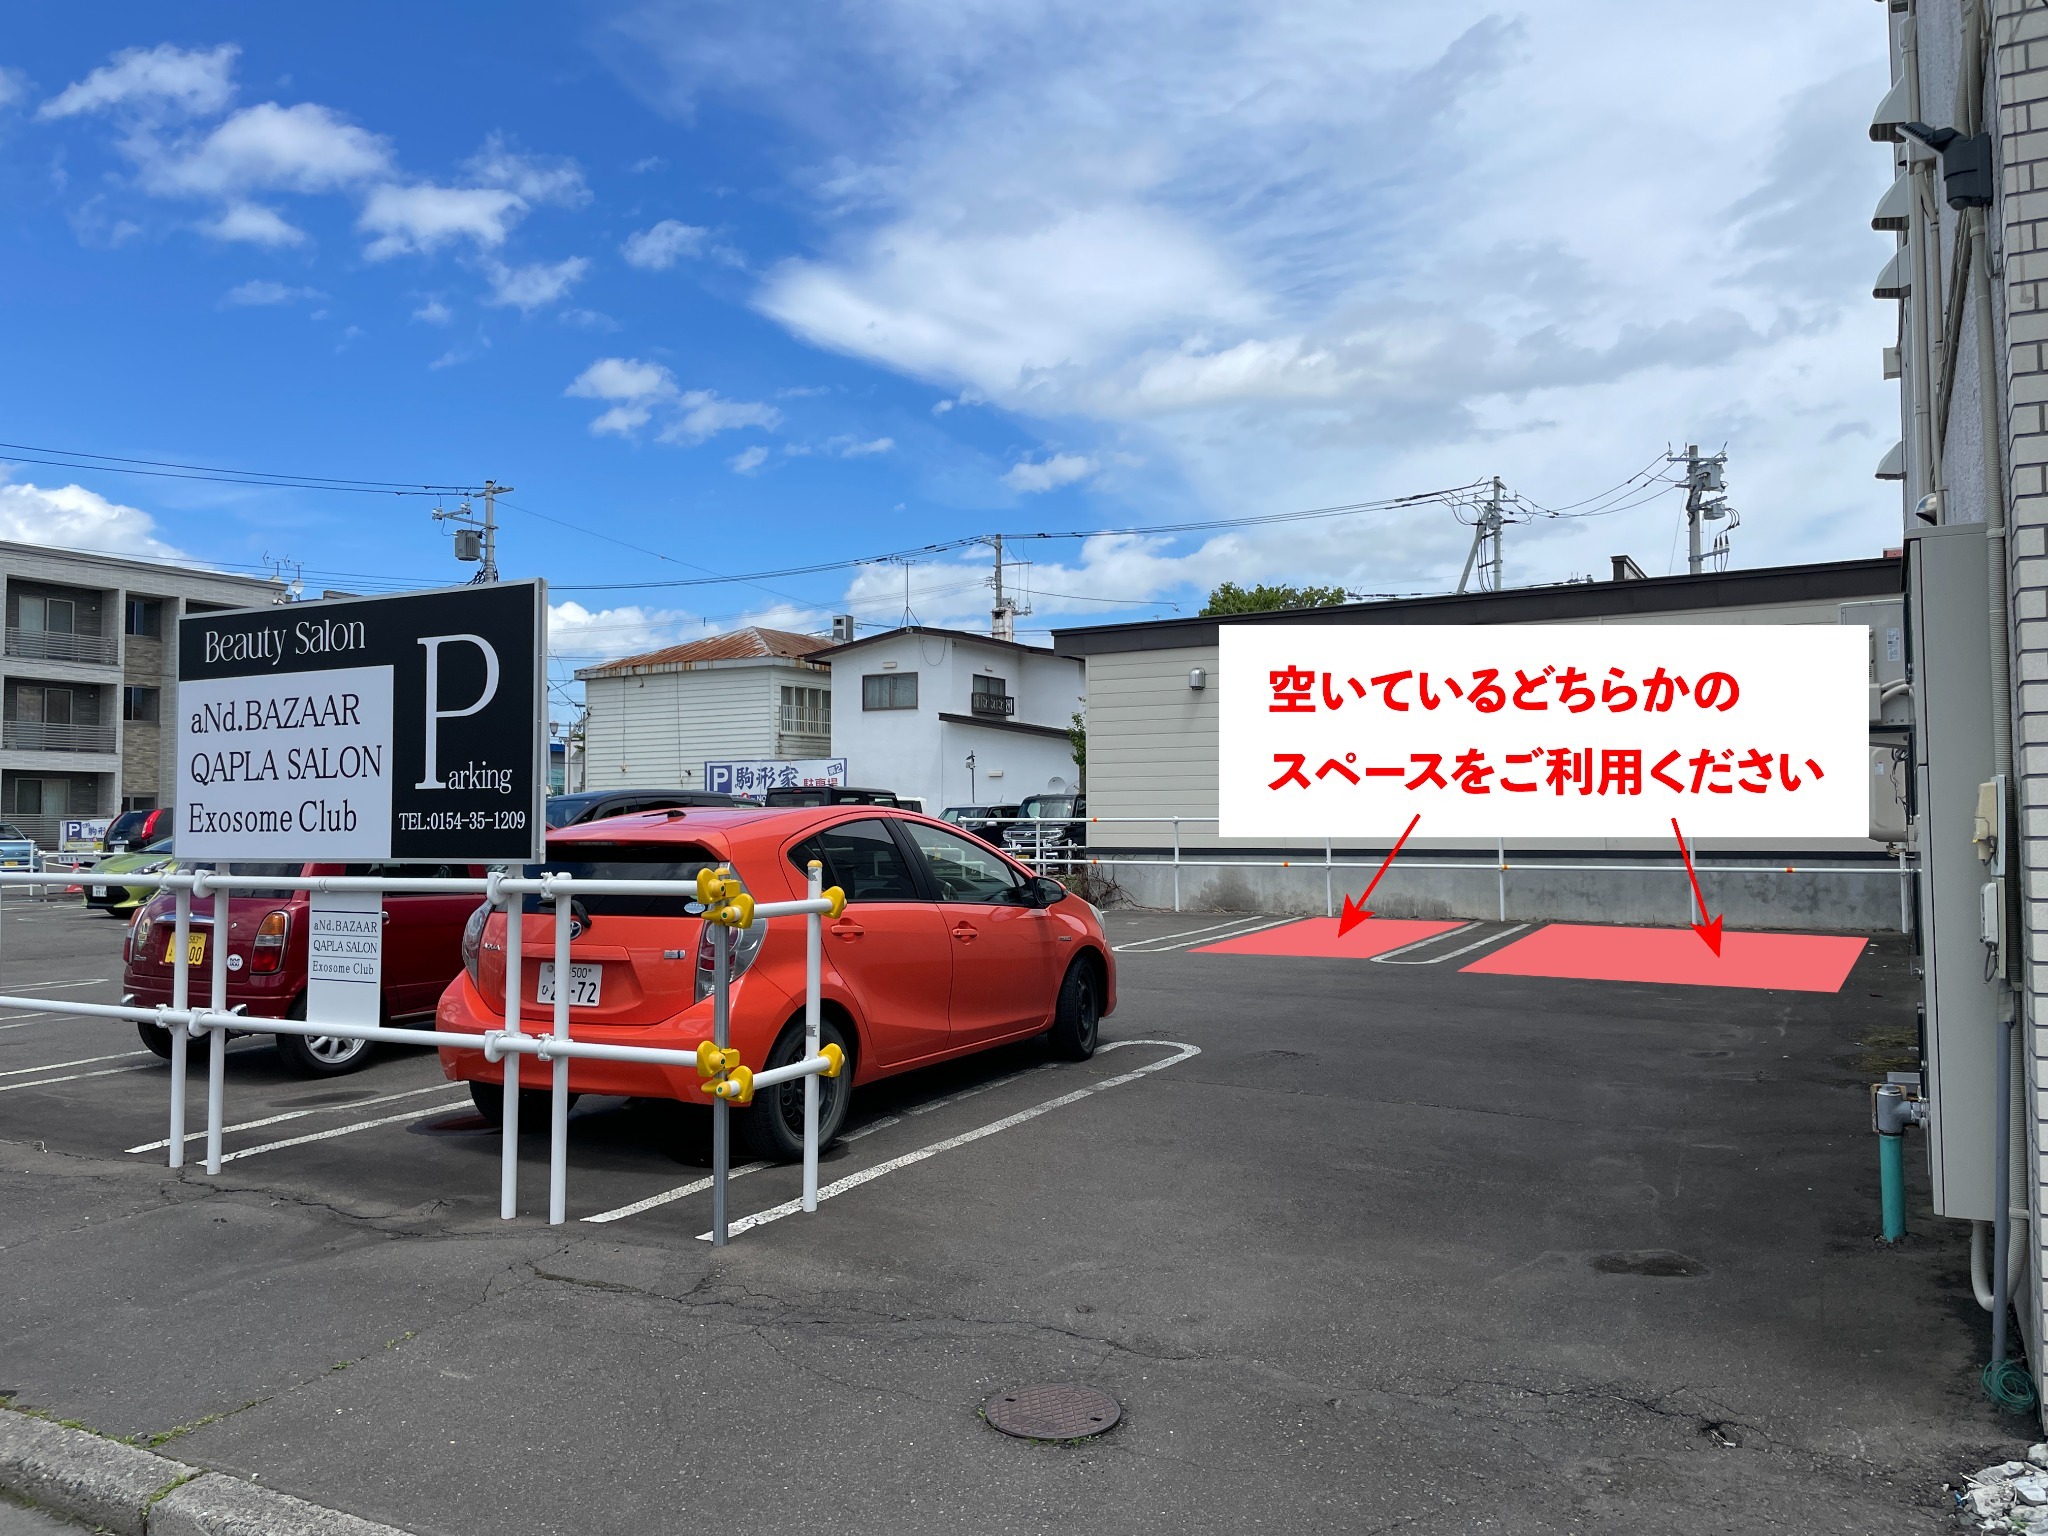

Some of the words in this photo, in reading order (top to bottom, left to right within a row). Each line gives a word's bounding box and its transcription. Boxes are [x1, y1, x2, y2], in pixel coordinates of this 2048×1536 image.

[205, 627, 287, 665] Beauty
[295, 619, 366, 655] Salon
[190, 693, 361, 734] aNd.BAZAAR
[191, 750, 279, 786] QAPLA
[287, 745, 382, 780] SALON
[713, 768, 728, 791] P
[734, 766, 799, 790] 駒形家
[188, 803, 293, 833] Exosome
[299, 799, 357, 833] Club
[398, 811, 526, 831] TEL:0154-35-1209
[69, 824, 80, 836] P
[313, 919, 378, 933] aNd.BAZAAR
[313, 939, 344, 952] QAPLA
[346, 941, 378, 954] SALON
[312, 960, 350, 974] Exosome
[353, 963, 374, 975] Club
